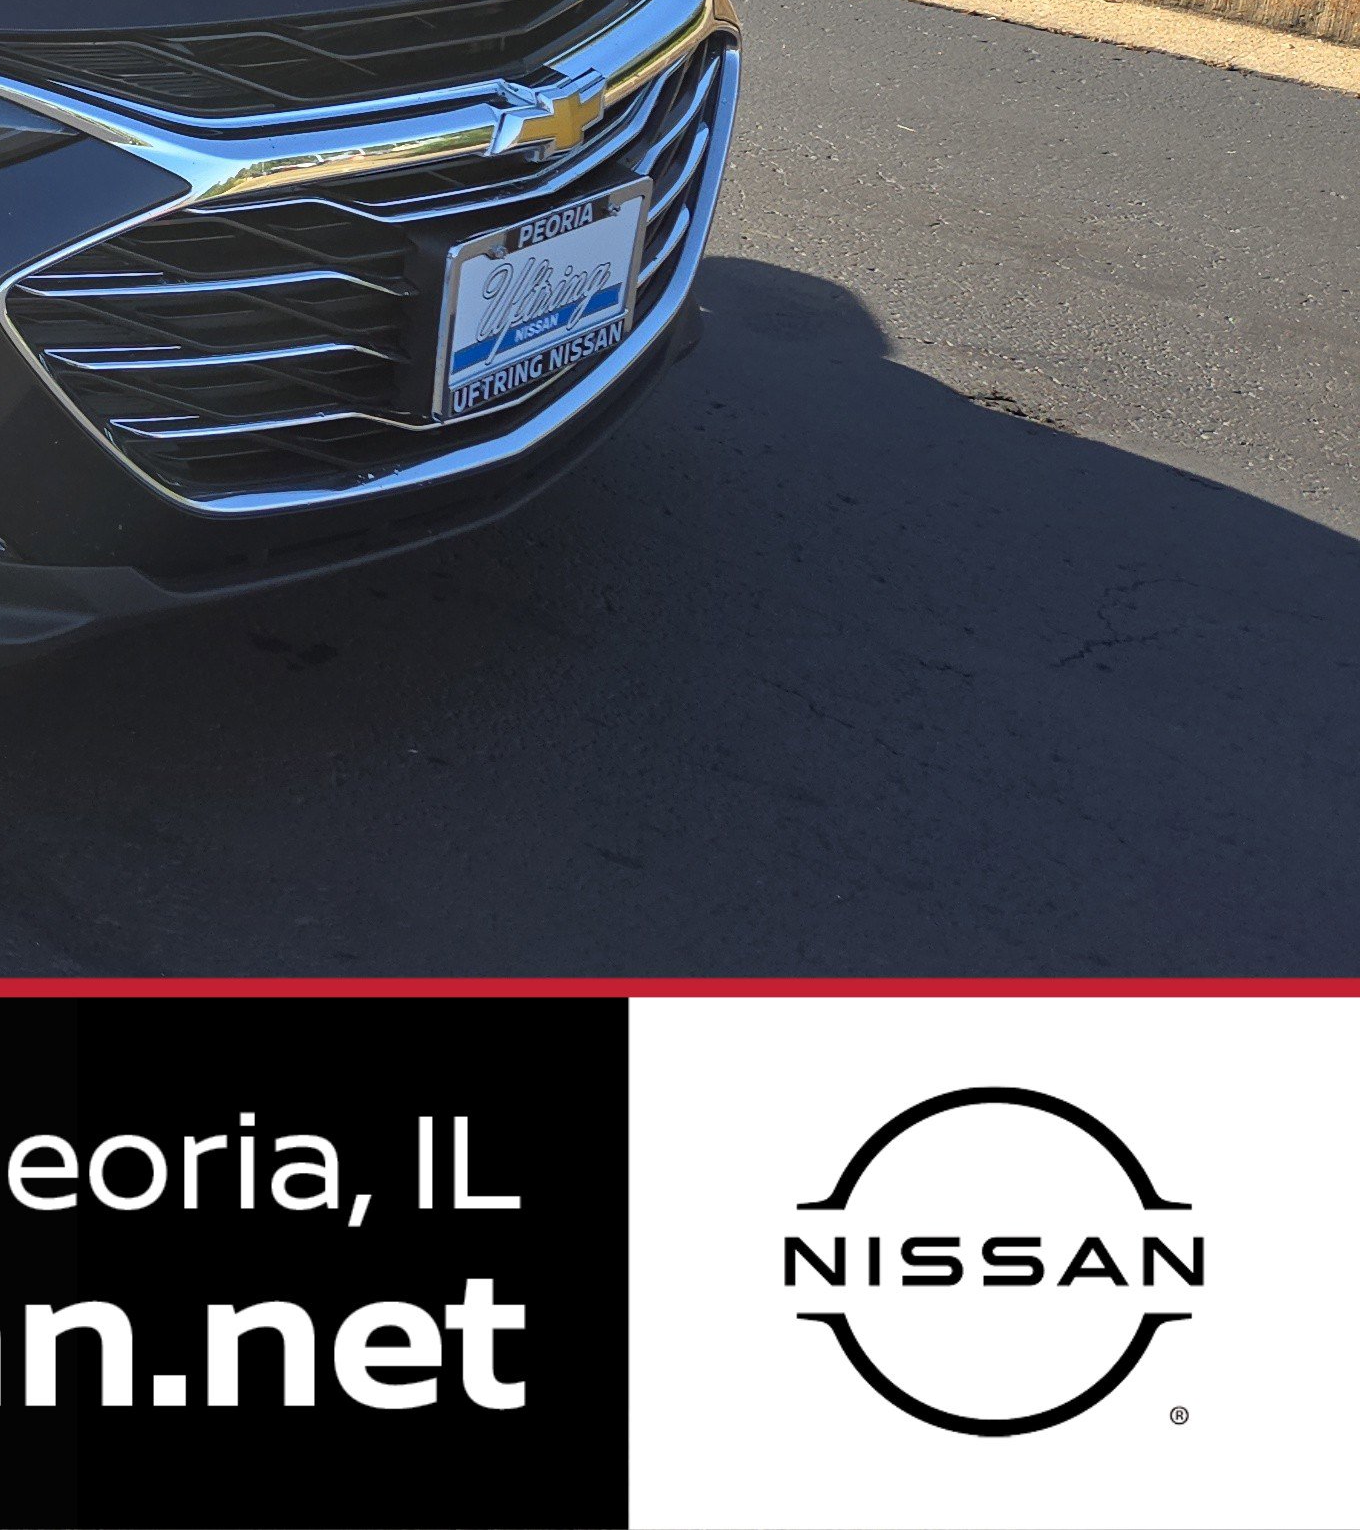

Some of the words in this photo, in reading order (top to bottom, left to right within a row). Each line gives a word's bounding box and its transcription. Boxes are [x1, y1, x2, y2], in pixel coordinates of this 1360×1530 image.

[518, 202, 593, 248] PEORIA
[476, 257, 611, 365] Uftring
[514, 313, 559, 343] NISSAN
[453, 354, 543, 413] UFTRING
[549, 321, 624, 371] NISSAN
